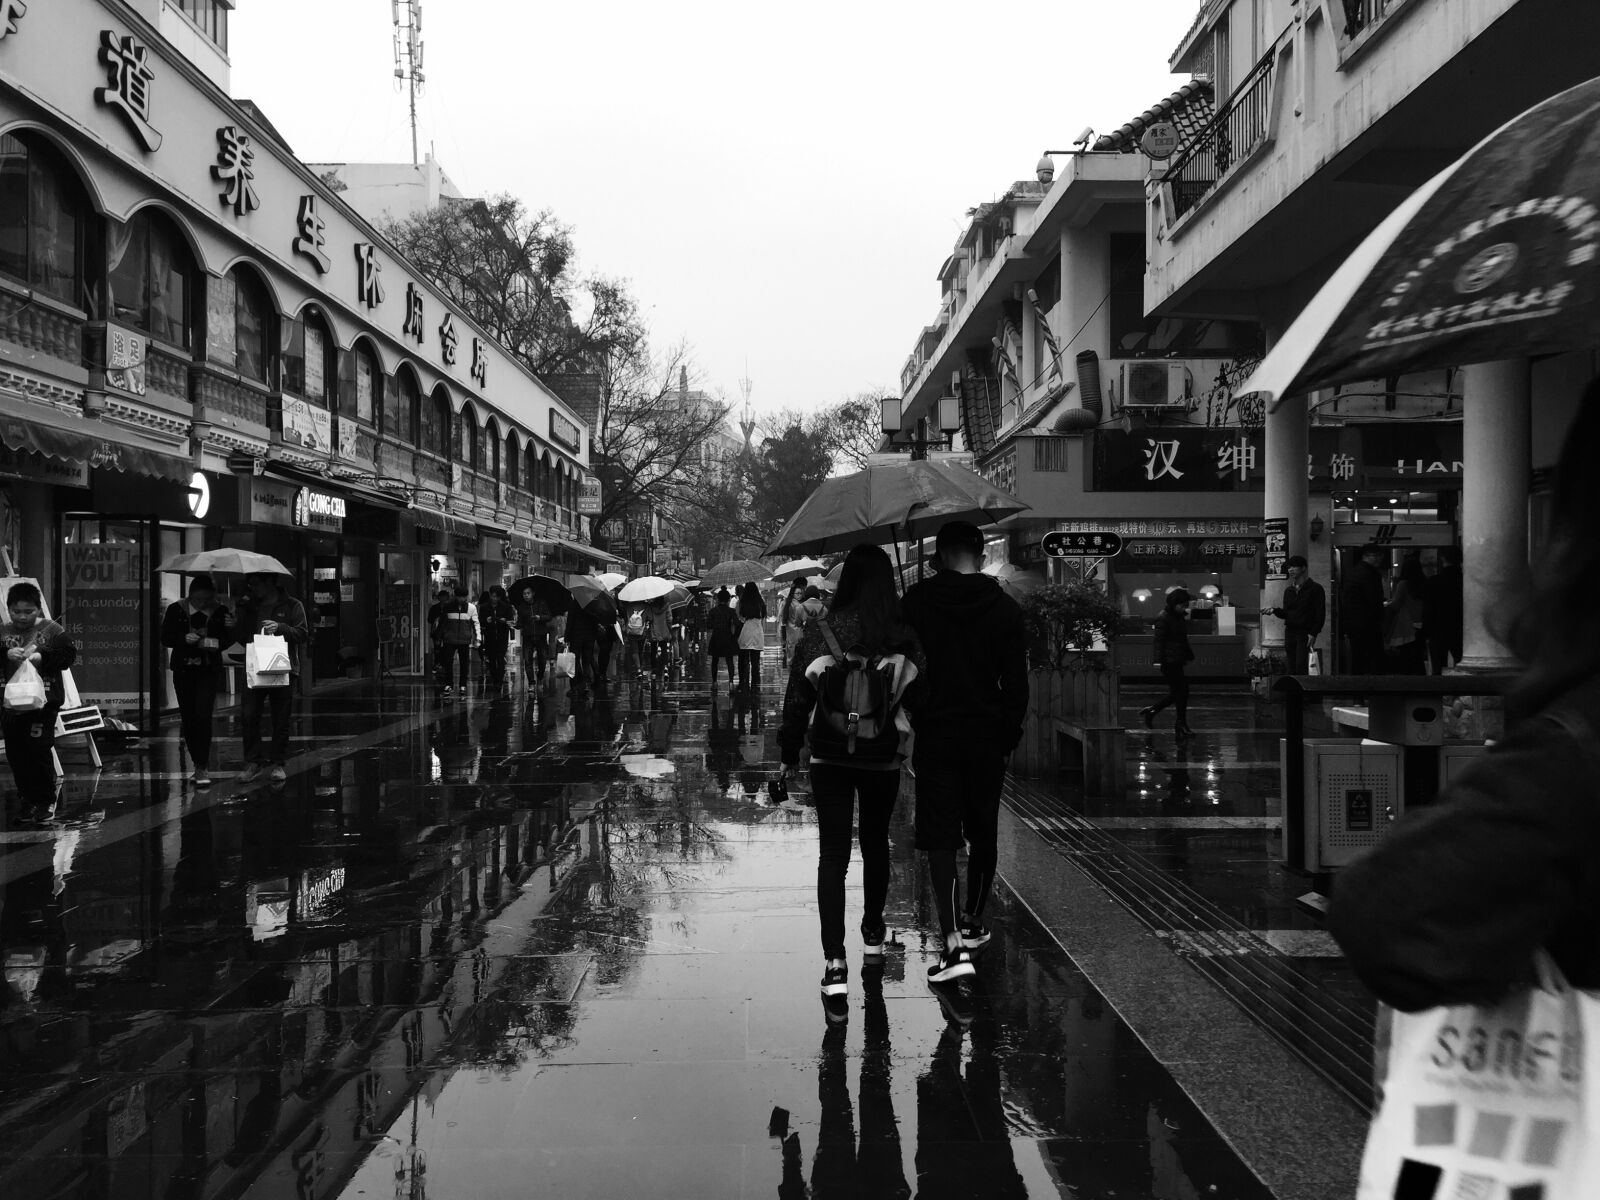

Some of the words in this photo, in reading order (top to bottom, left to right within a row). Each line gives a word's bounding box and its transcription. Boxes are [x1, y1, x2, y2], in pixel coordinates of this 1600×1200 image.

[0, 0, 489, 388] 道养生休闲会所
[1143, 437, 1256, 482] 汉绅
[309, 492, 331, 515] GONG
[331, 497, 346, 518] CHA
[72, 547, 122, 562] WANT
[1134, 543, 1180, 555] 正新鸡排
[1204, 543, 1257, 555] 台湾手抓饼
[78, 595, 140, 610] in.sunday
[30, 722, 43, 738] 5
